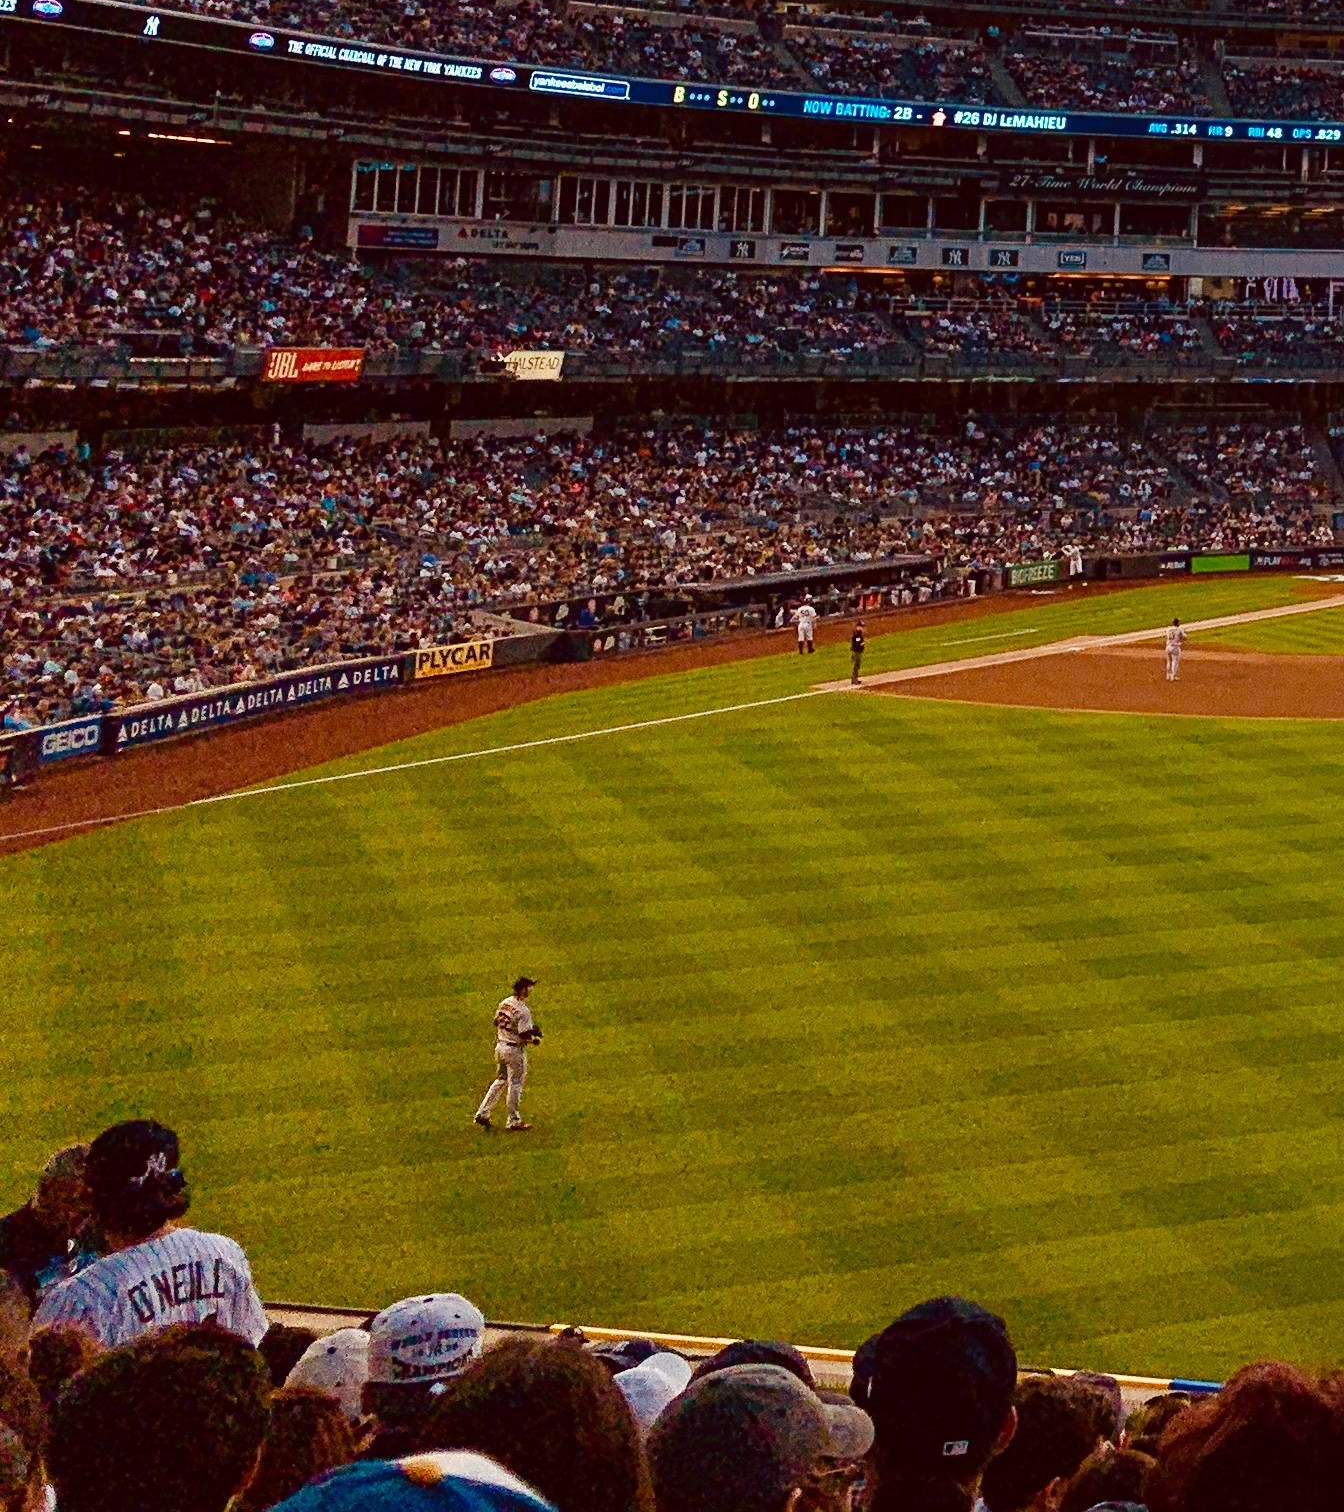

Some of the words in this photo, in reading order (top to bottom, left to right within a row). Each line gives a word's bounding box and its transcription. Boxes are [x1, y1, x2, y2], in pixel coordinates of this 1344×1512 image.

[288, 40, 304, 54] THE
[305, 44, 336, 59] OFFICIAL
[339, 49, 375, 64] CHARCOAL
[377, 54, 388, 66] OF
[389, 56, 403, 69] THE
[404, 58, 422, 71] NEW
[423, 62, 442, 74] YORK
[444, 64, 482, 78] YANKEES
[673, 85, 687, 106] B
[717, 88, 729, 108] S
[748, 91, 761, 111] O
[802, 99, 834, 117] NOW
[835, 101, 892, 120] BATTING:
[893, 105, 913, 122] 2B
[953, 110, 981, 126] #26
[982, 113, 998, 127] DJ
[1148, 122, 1169, 135] AVG
[1170, 123, 1198, 136] .314
[1208, 125, 1224, 137] HR
[1224, 125, 1234, 138] 9
[1248, 126, 1265, 138] RBI
[1266, 127, 1283, 139] 48
[1292, 127, 1312, 139] OPS
[1314, 129, 1342, 141] .829
[470, 229, 509, 238] DELTA
[268, 352, 299, 378] JBL
[418, 643, 492, 670] PLYCAR
[353, 664, 398, 684] DELTA
[298, 677, 331, 697] DELTA
[247, 689, 282, 710] DELTA
[190, 701, 230, 723] DELTA
[130, 714, 172, 737] DELTA
[42, 725, 98, 755] GEICO
